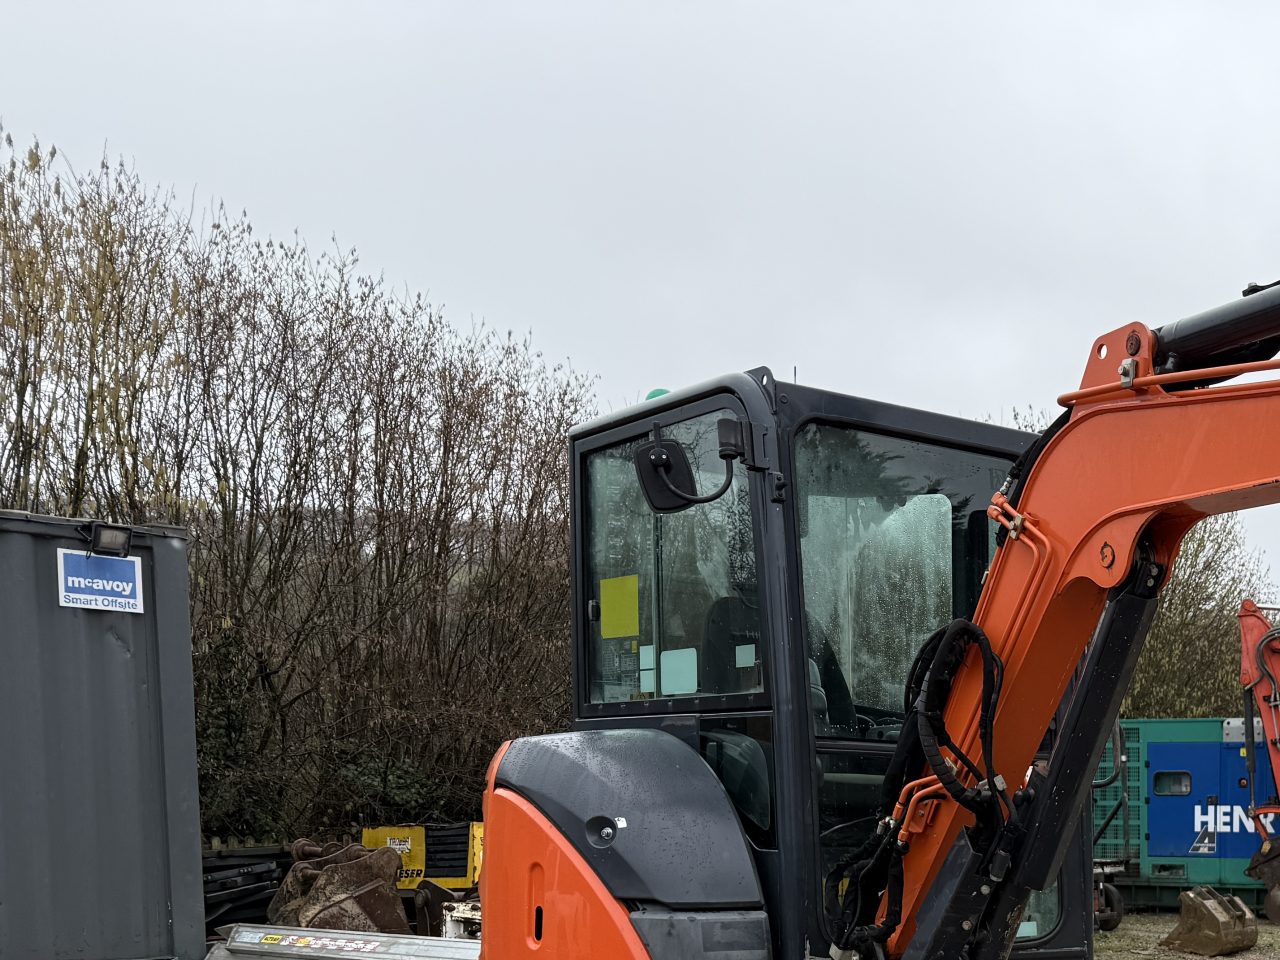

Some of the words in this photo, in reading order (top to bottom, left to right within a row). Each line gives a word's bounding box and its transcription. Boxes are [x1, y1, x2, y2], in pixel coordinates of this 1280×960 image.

[67, 576, 133, 595] mcavoy
[64, 595, 98, 606] Smart
[102, 598, 138, 610] Offsite
